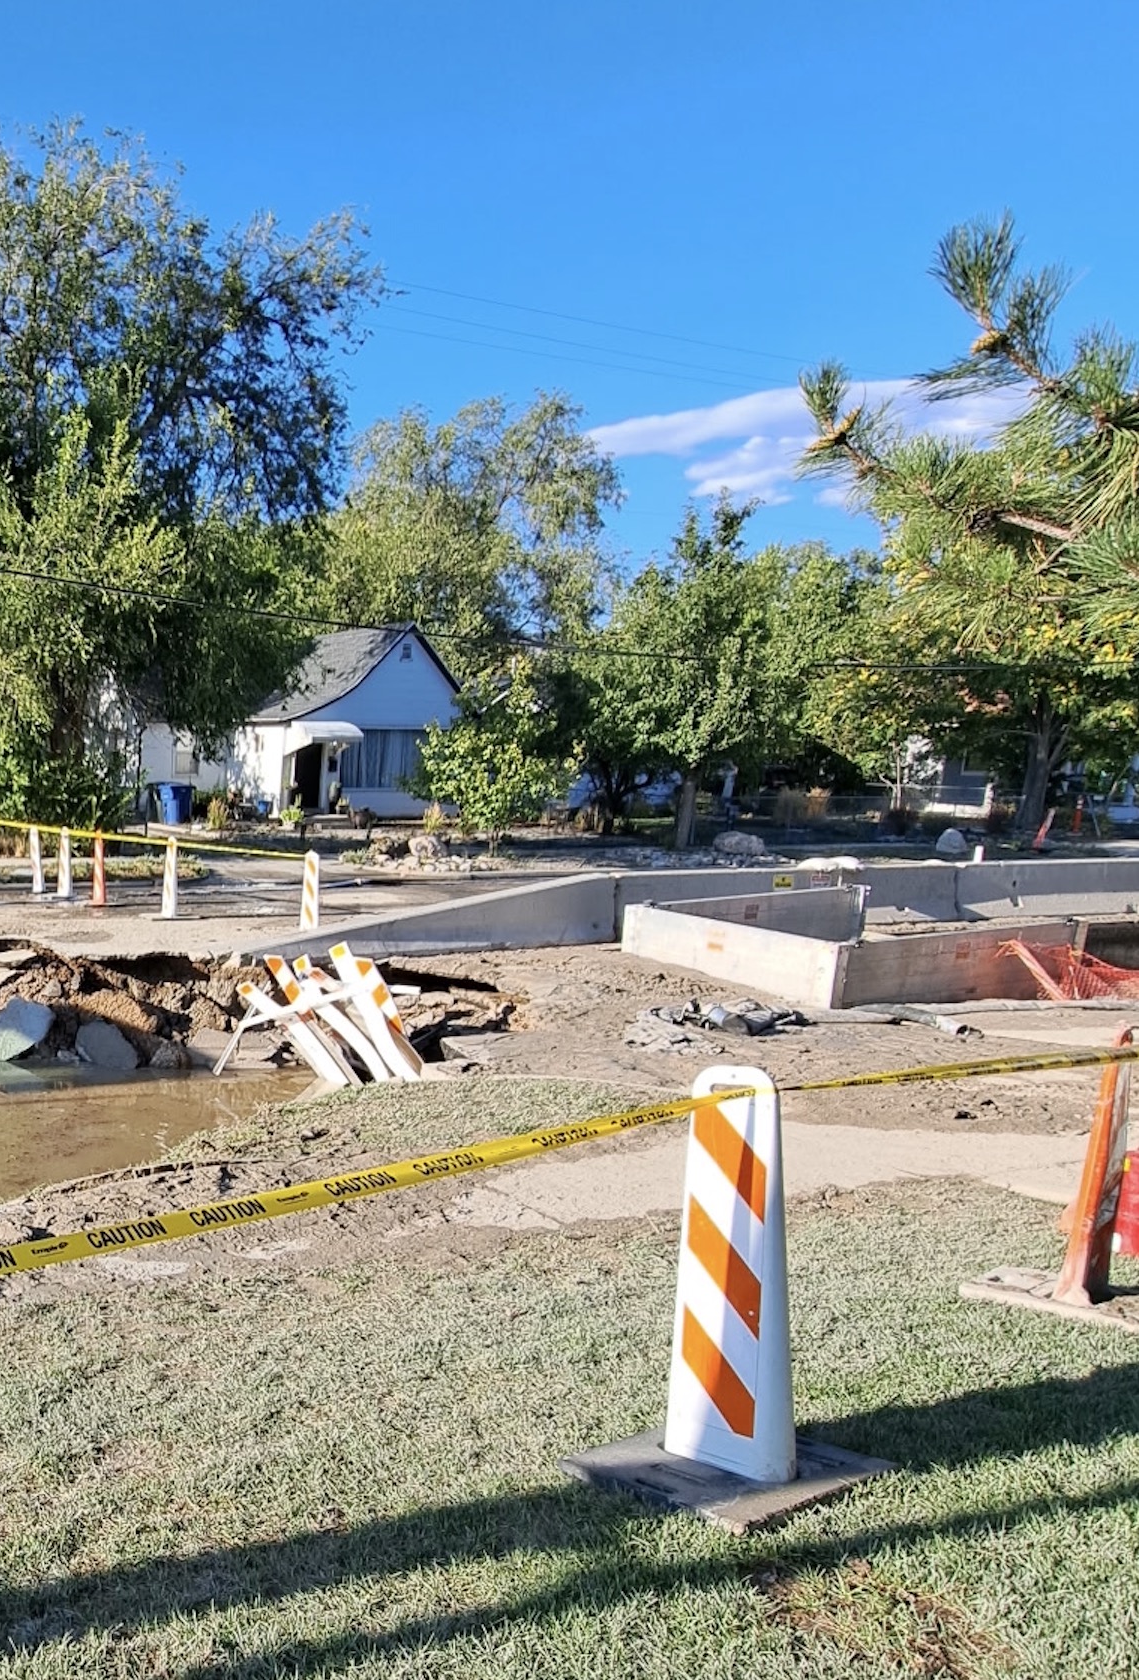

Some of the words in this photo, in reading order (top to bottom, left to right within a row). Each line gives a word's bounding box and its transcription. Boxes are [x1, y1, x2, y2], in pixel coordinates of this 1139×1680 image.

[413, 1152, 484, 1177] CAUTION
[324, 1171, 397, 1197] CAUTION
[189, 1199, 266, 1227] CAUTION
[87, 1220, 168, 1249] CAUTION
